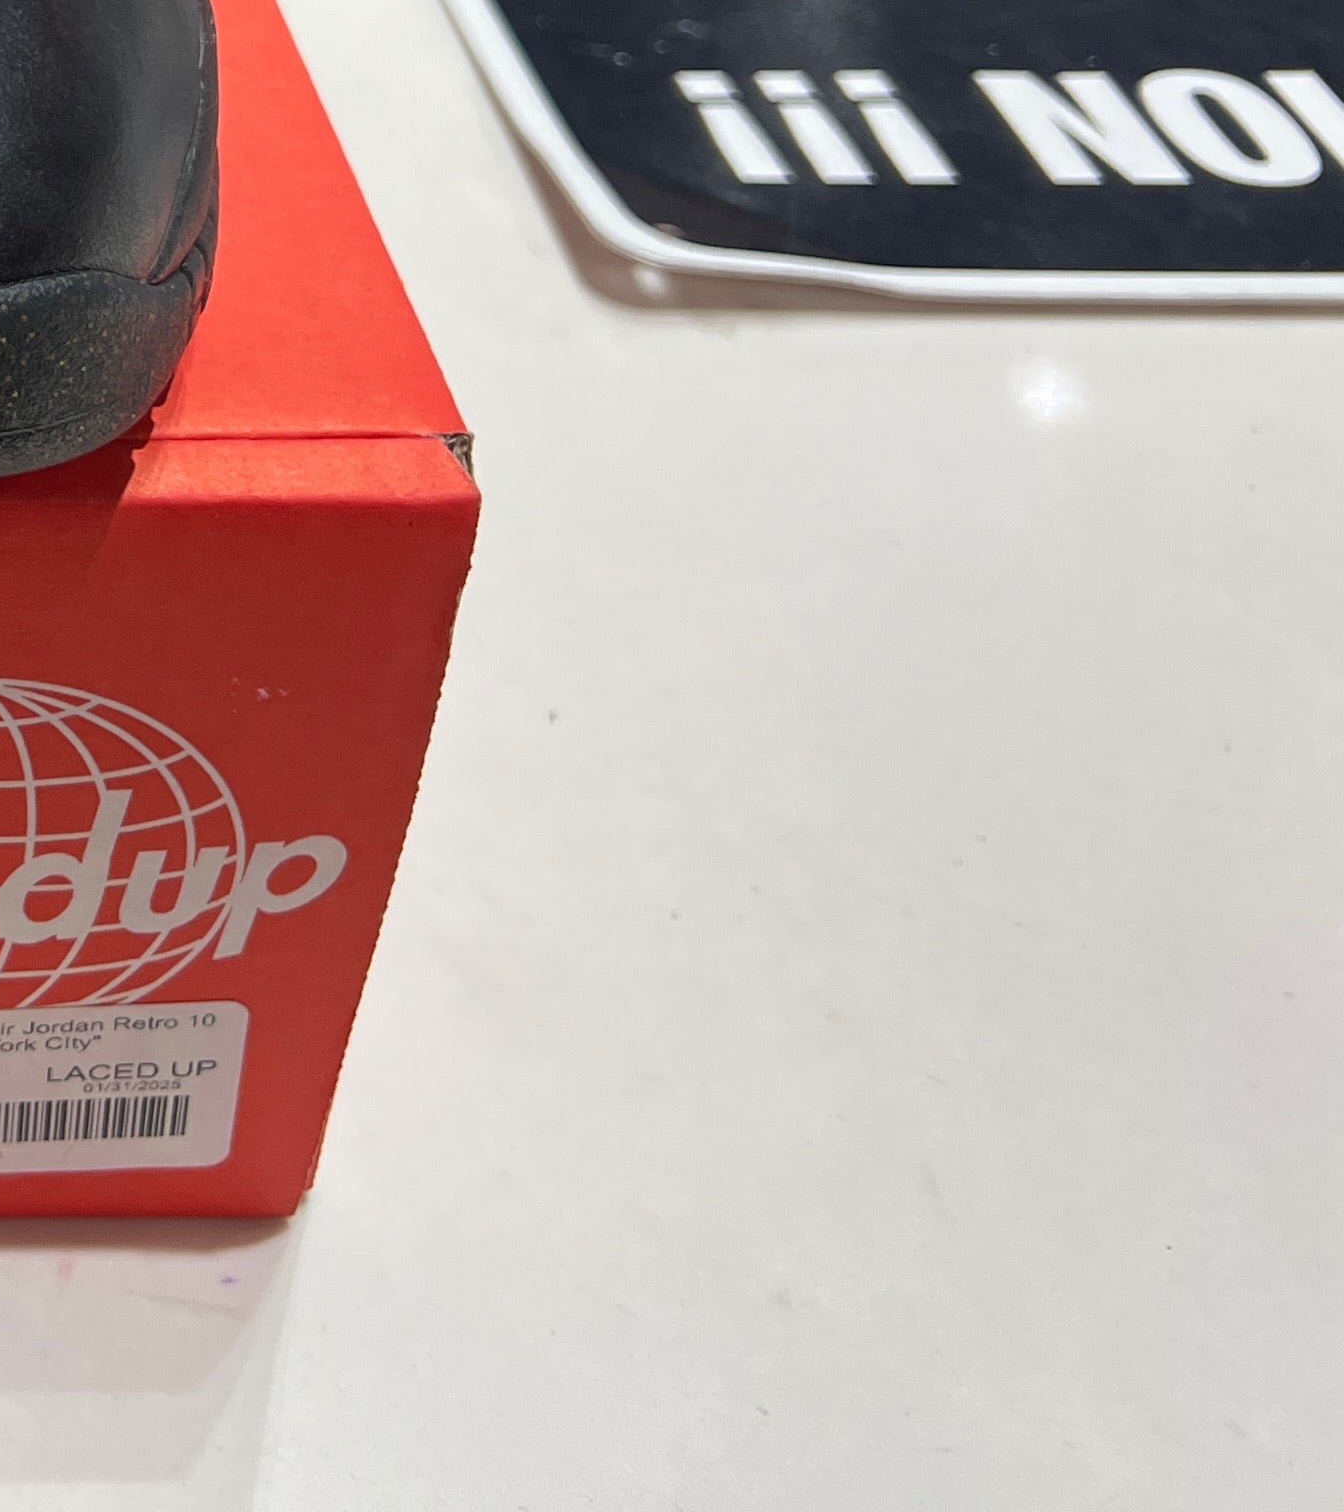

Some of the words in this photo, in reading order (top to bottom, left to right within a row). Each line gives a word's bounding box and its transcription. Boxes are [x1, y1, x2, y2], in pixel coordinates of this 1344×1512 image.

[22, 1018, 104, 1035] Jordan
[113, 1015, 178, 1031] Retro
[190, 1013, 217, 1028] 10
[45, 1035, 102, 1052] City"
[47, 1062, 160, 1083] LACED
[171, 1059, 217, 1078] UP
[82, 1078, 182, 1094] 01/31/2025
